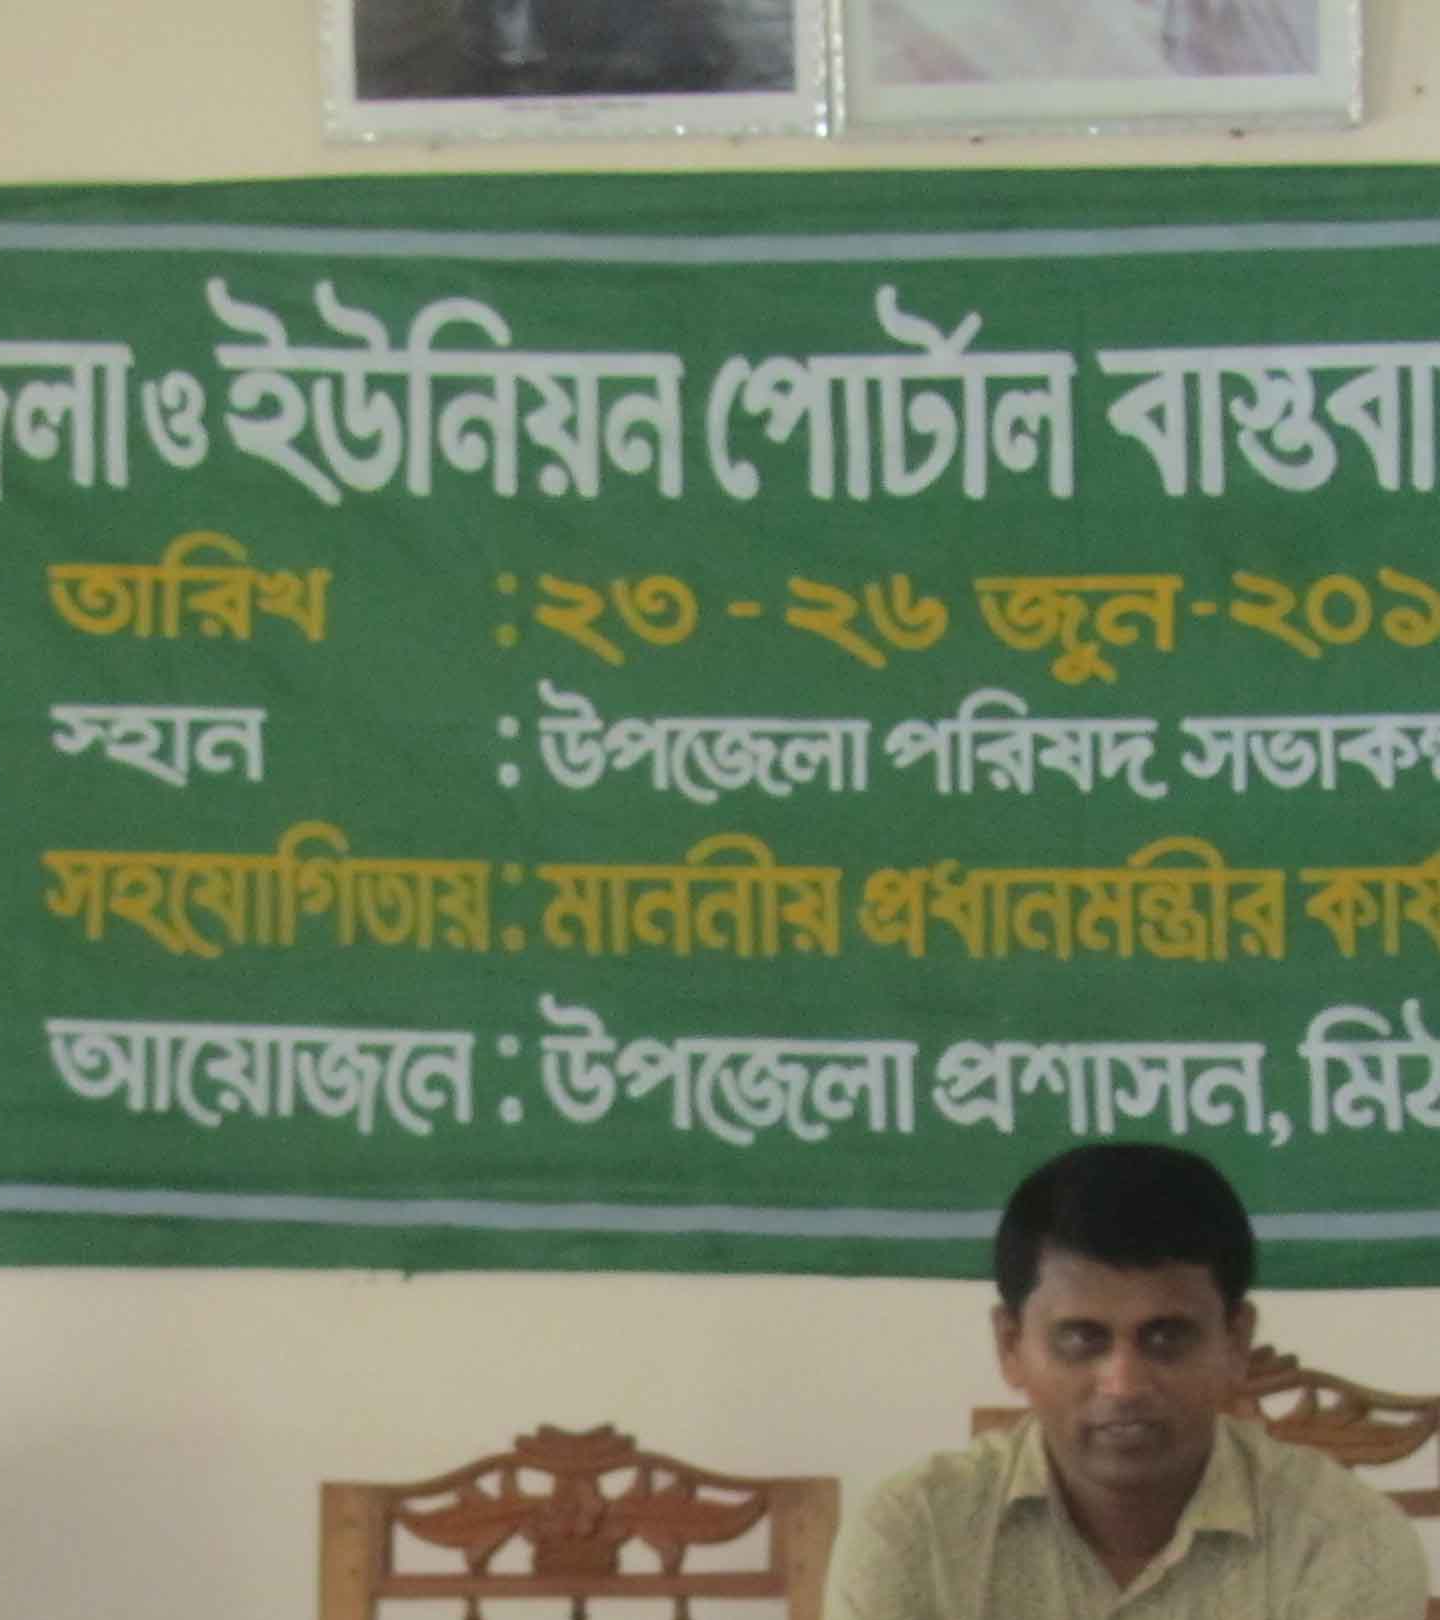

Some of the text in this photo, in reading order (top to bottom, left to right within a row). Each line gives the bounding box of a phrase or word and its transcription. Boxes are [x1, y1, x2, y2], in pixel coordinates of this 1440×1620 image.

[144, 370, 206, 466] ও
[205, 275, 682, 505] ইউনিয়ন
[708, 285, 1076, 497] পোর্টাল
[45, 529, 332, 643] তারিখ
[887, 688, 1170, 796] পরিষদ
[854, 834, 1288, 963] প্রধানমন্ত্রীর
[541, 995, 918, 1142] উপজেলা
